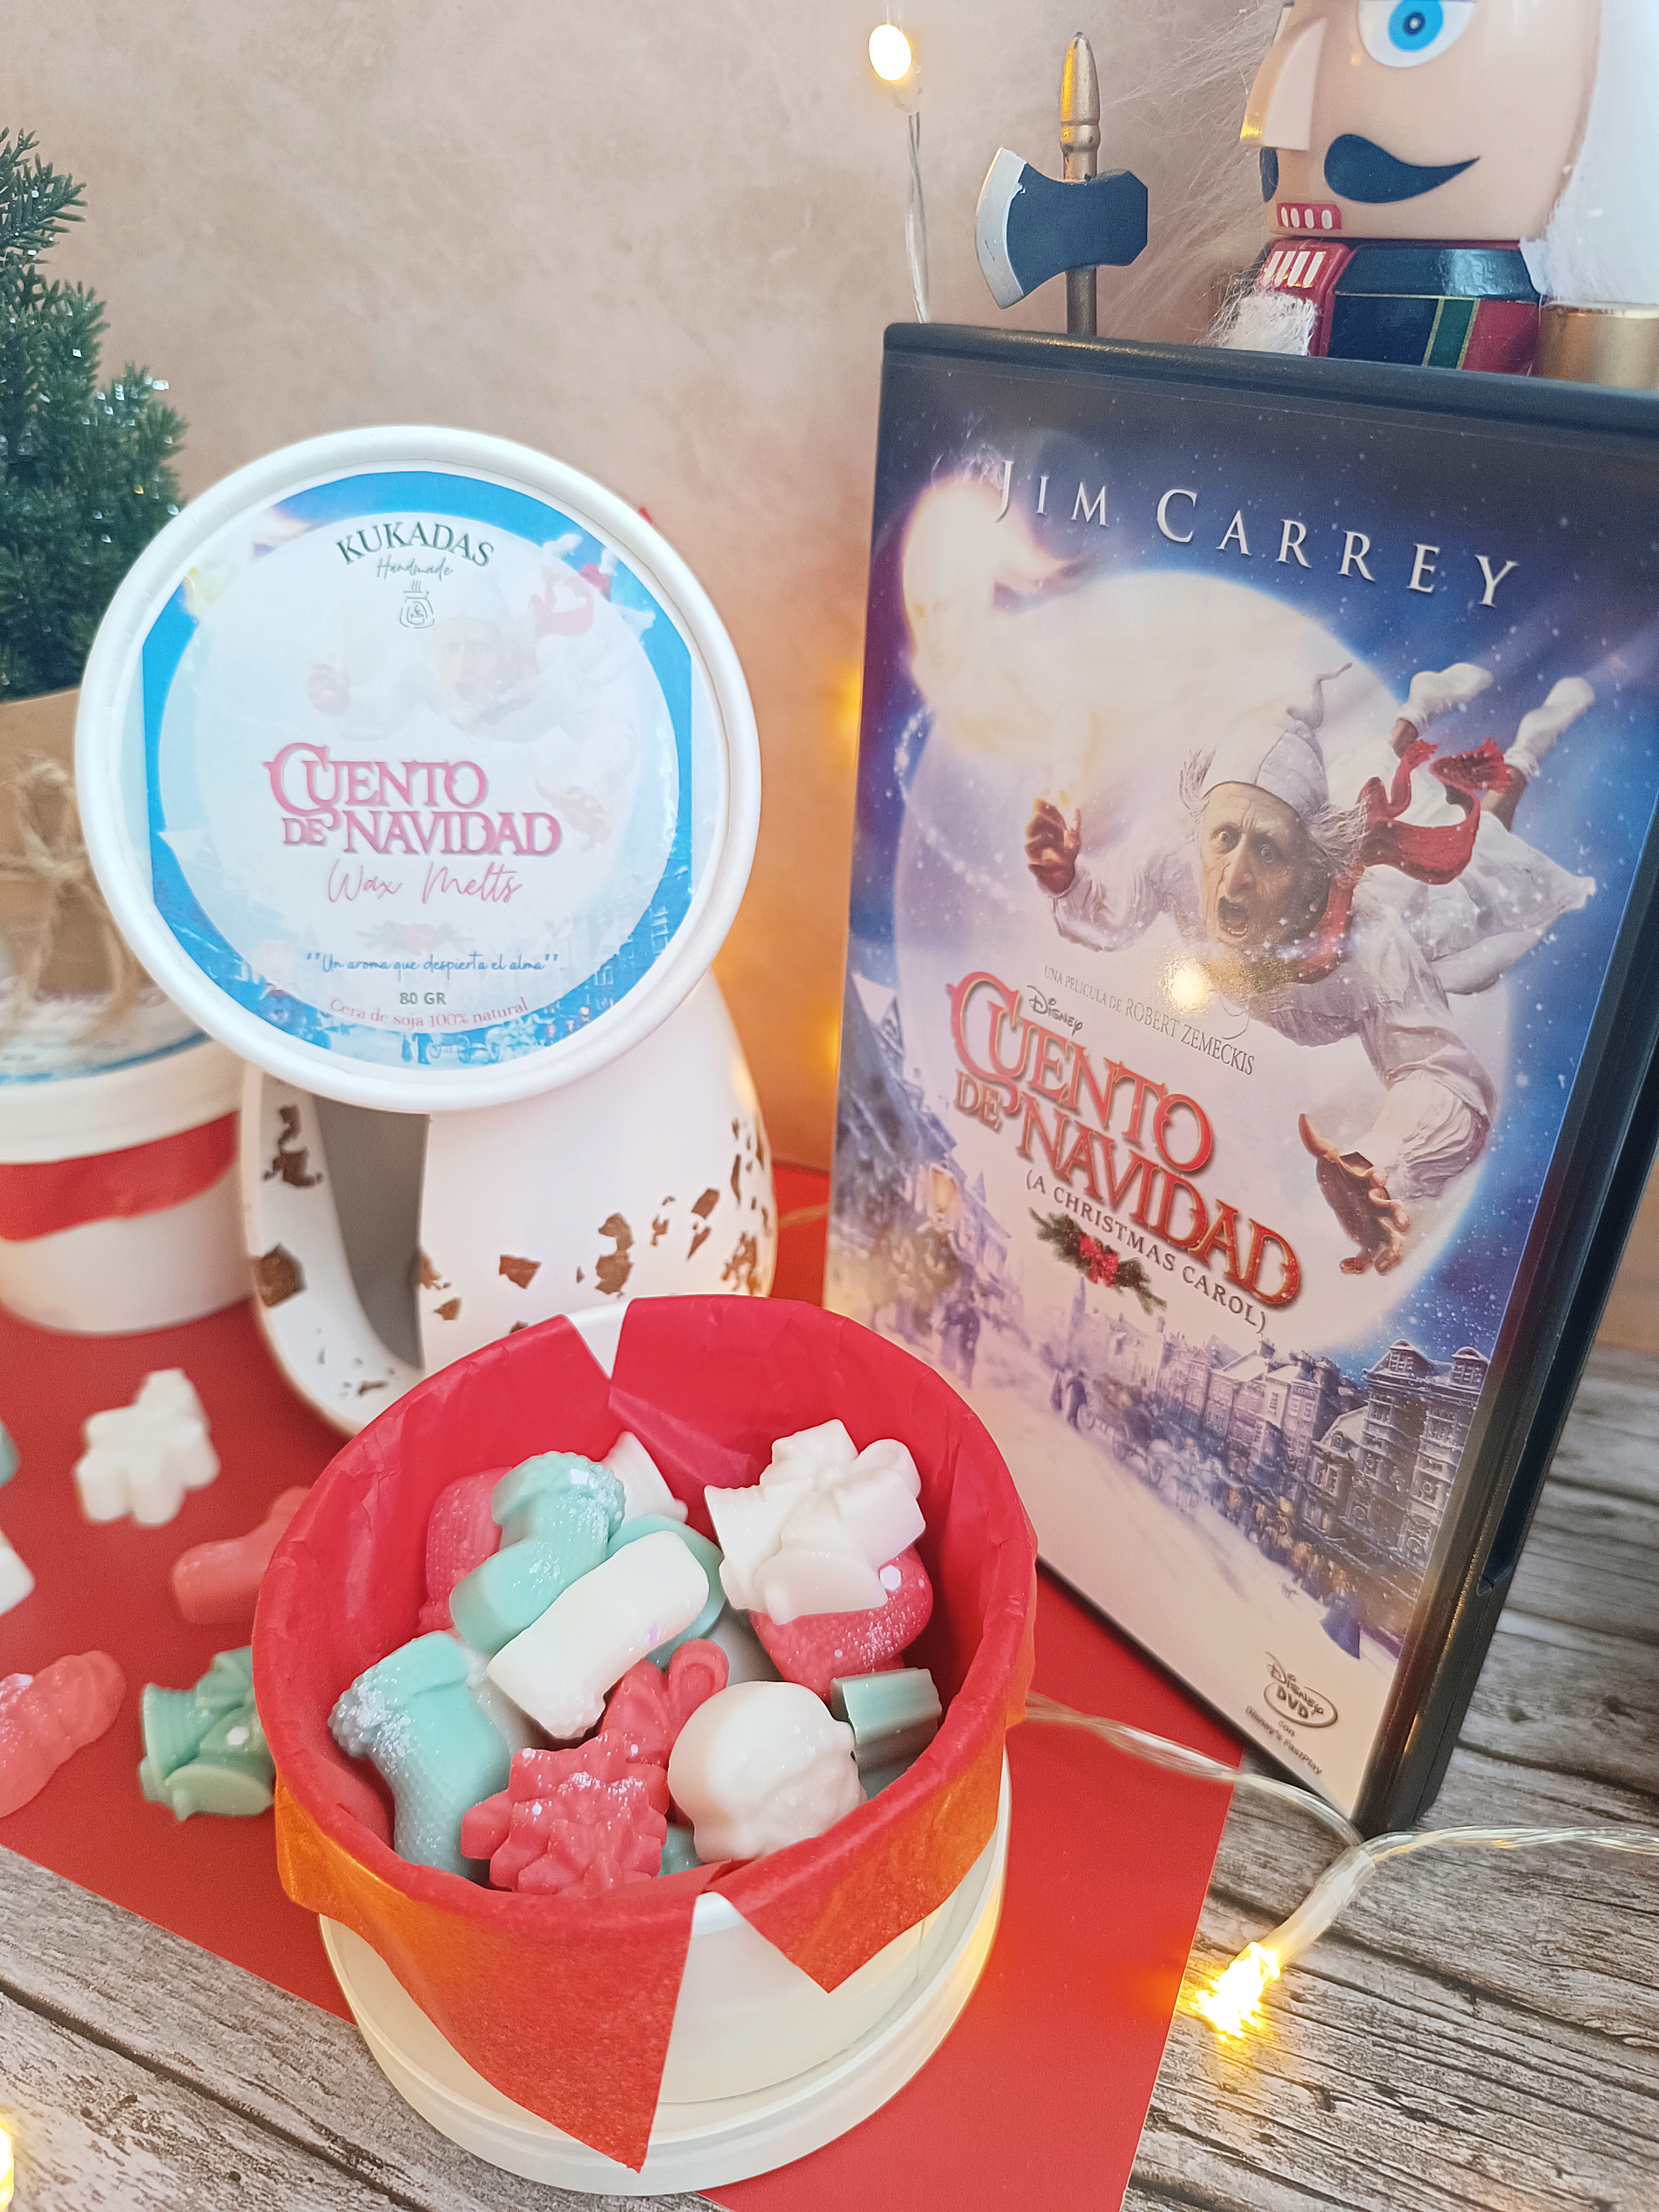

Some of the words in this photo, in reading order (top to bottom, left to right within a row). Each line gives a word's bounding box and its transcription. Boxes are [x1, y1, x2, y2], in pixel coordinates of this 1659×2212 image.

[336, 521, 494, 567] KUKADAS
[995, 461, 1109, 527] JIM
[1156, 488, 1519, 608] CARREY
[377, 555, 453, 581] Handmade
[262, 742, 488, 831] CUENTO
[282, 818, 326, 846] DE
[343, 811, 563, 856] NAVIDAD
[327, 859, 403, 903] Wax
[422, 861, 523, 904] Melts
[348, 961, 392, 969] aroma
[394, 961, 420, 982] que
[423, 951, 488, 981] despierta
[491, 954, 506, 970] el
[330, 999, 365, 1019] Cera
[371, 1007, 388, 1022] de
[394, 1015, 423, 1029] soja
[430, 1013, 469, 1026] 100%
[473, 996, 528, 1024] natural
[400, 992, 417, 1005] 80
[424, 992, 447, 1005] GR
[1027, 985, 1083, 1037] Disney
[1044, 966, 1063, 985] UNA
[1109, 995, 1122, 1013] DE
[1125, 998, 1180, 1038] ROBERT
[1181, 1024, 1254, 1075] ZEMECKIS
[946, 972, 1213, 1172] CUENTO
[954, 1069, 1004, 1132] DE
[1017, 1091, 1302, 1304] NAVIDAD
[1026, 1169, 1046, 1194] (A
[1053, 1186, 1176, 1272] CHRISTMAS
[1182, 1265, 1266, 1334] CAROL)
[1265, 1651, 1324, 1715] Disney
[1276, 1683, 1308, 1718] DVD
[1245, 1706, 1282, 1740] Disney's
[1278, 1720, 1295, 1736] con
